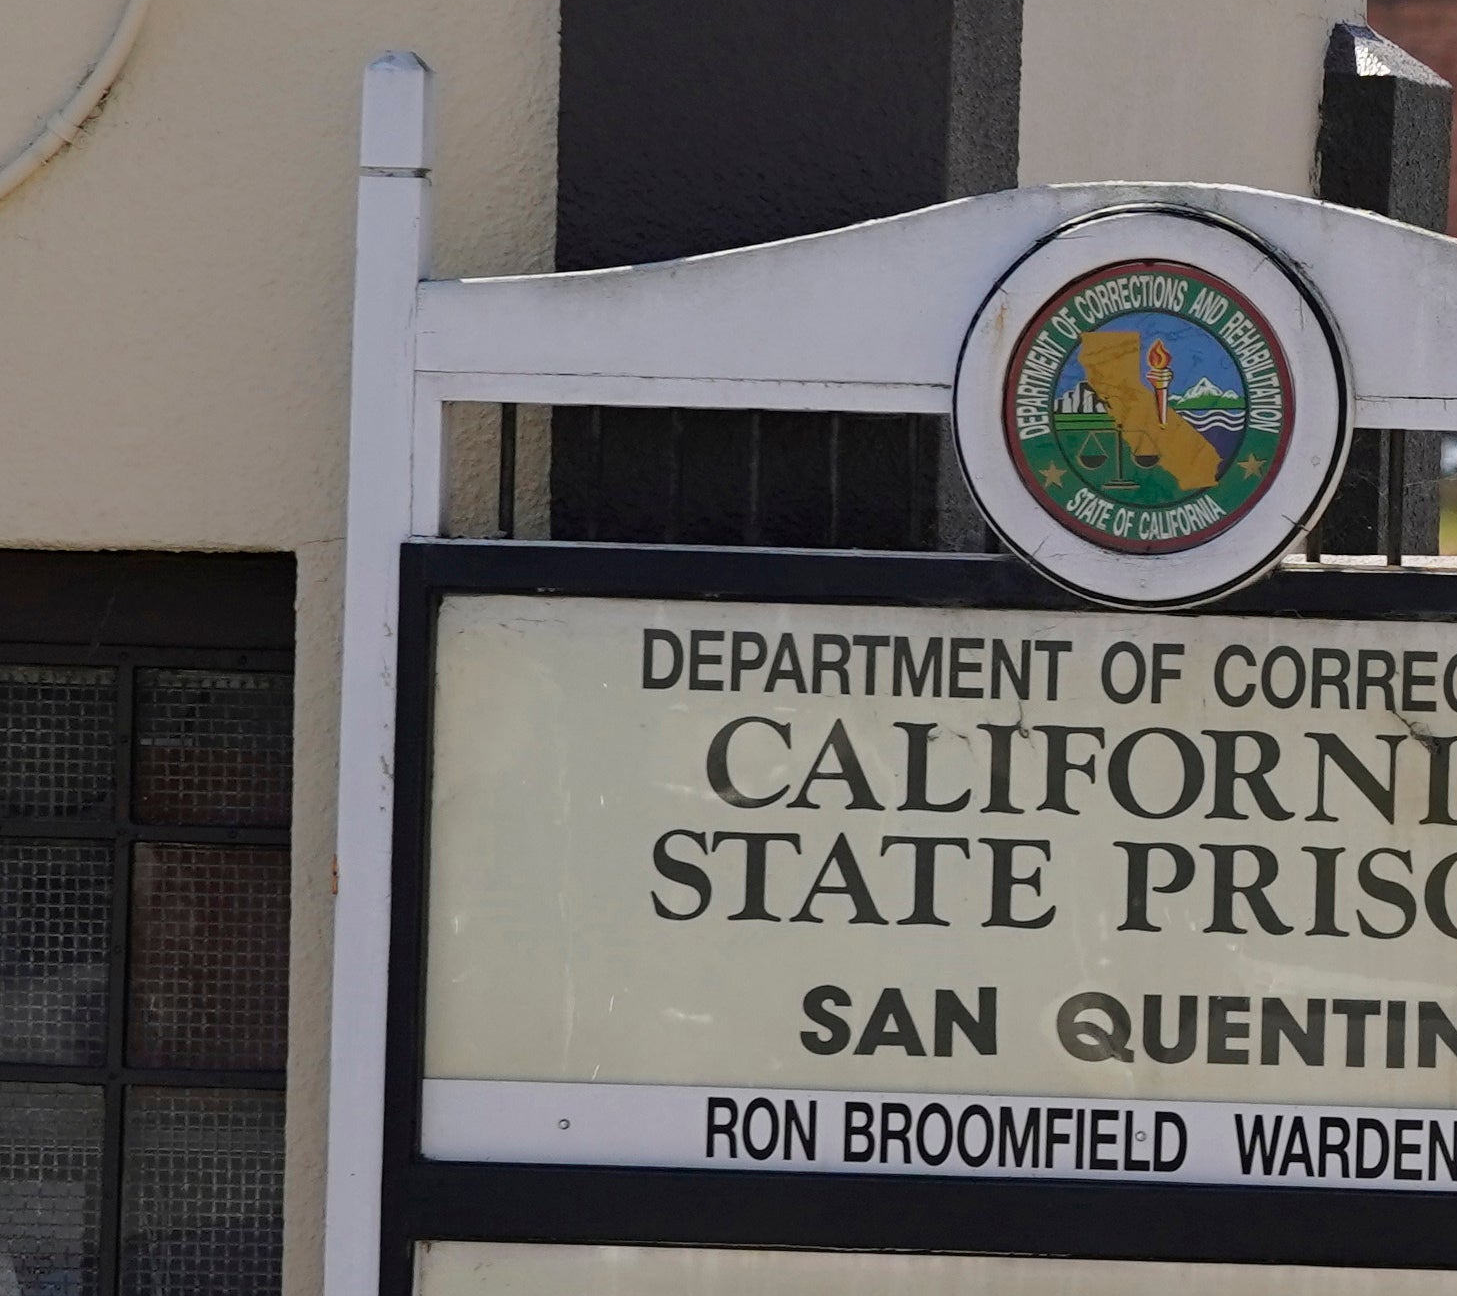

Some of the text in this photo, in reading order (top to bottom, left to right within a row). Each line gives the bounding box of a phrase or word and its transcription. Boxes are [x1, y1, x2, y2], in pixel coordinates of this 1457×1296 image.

[1015, 275, 1283, 440] DEPARTMENT OF CORRECTIONS AND REHABILITATION
[1066, 487, 1227, 540] STATE OF CALIFORNIA
[642, 628, 1072, 701] DEPARTMENT
[1101, 641, 1185, 704] OF
[651, 829, 1056, 929] STATE
[800, 985, 997, 1057] SAN
[706, 1097, 817, 1160] RON
[844, 1101, 1187, 1171] BROOMFIELD
